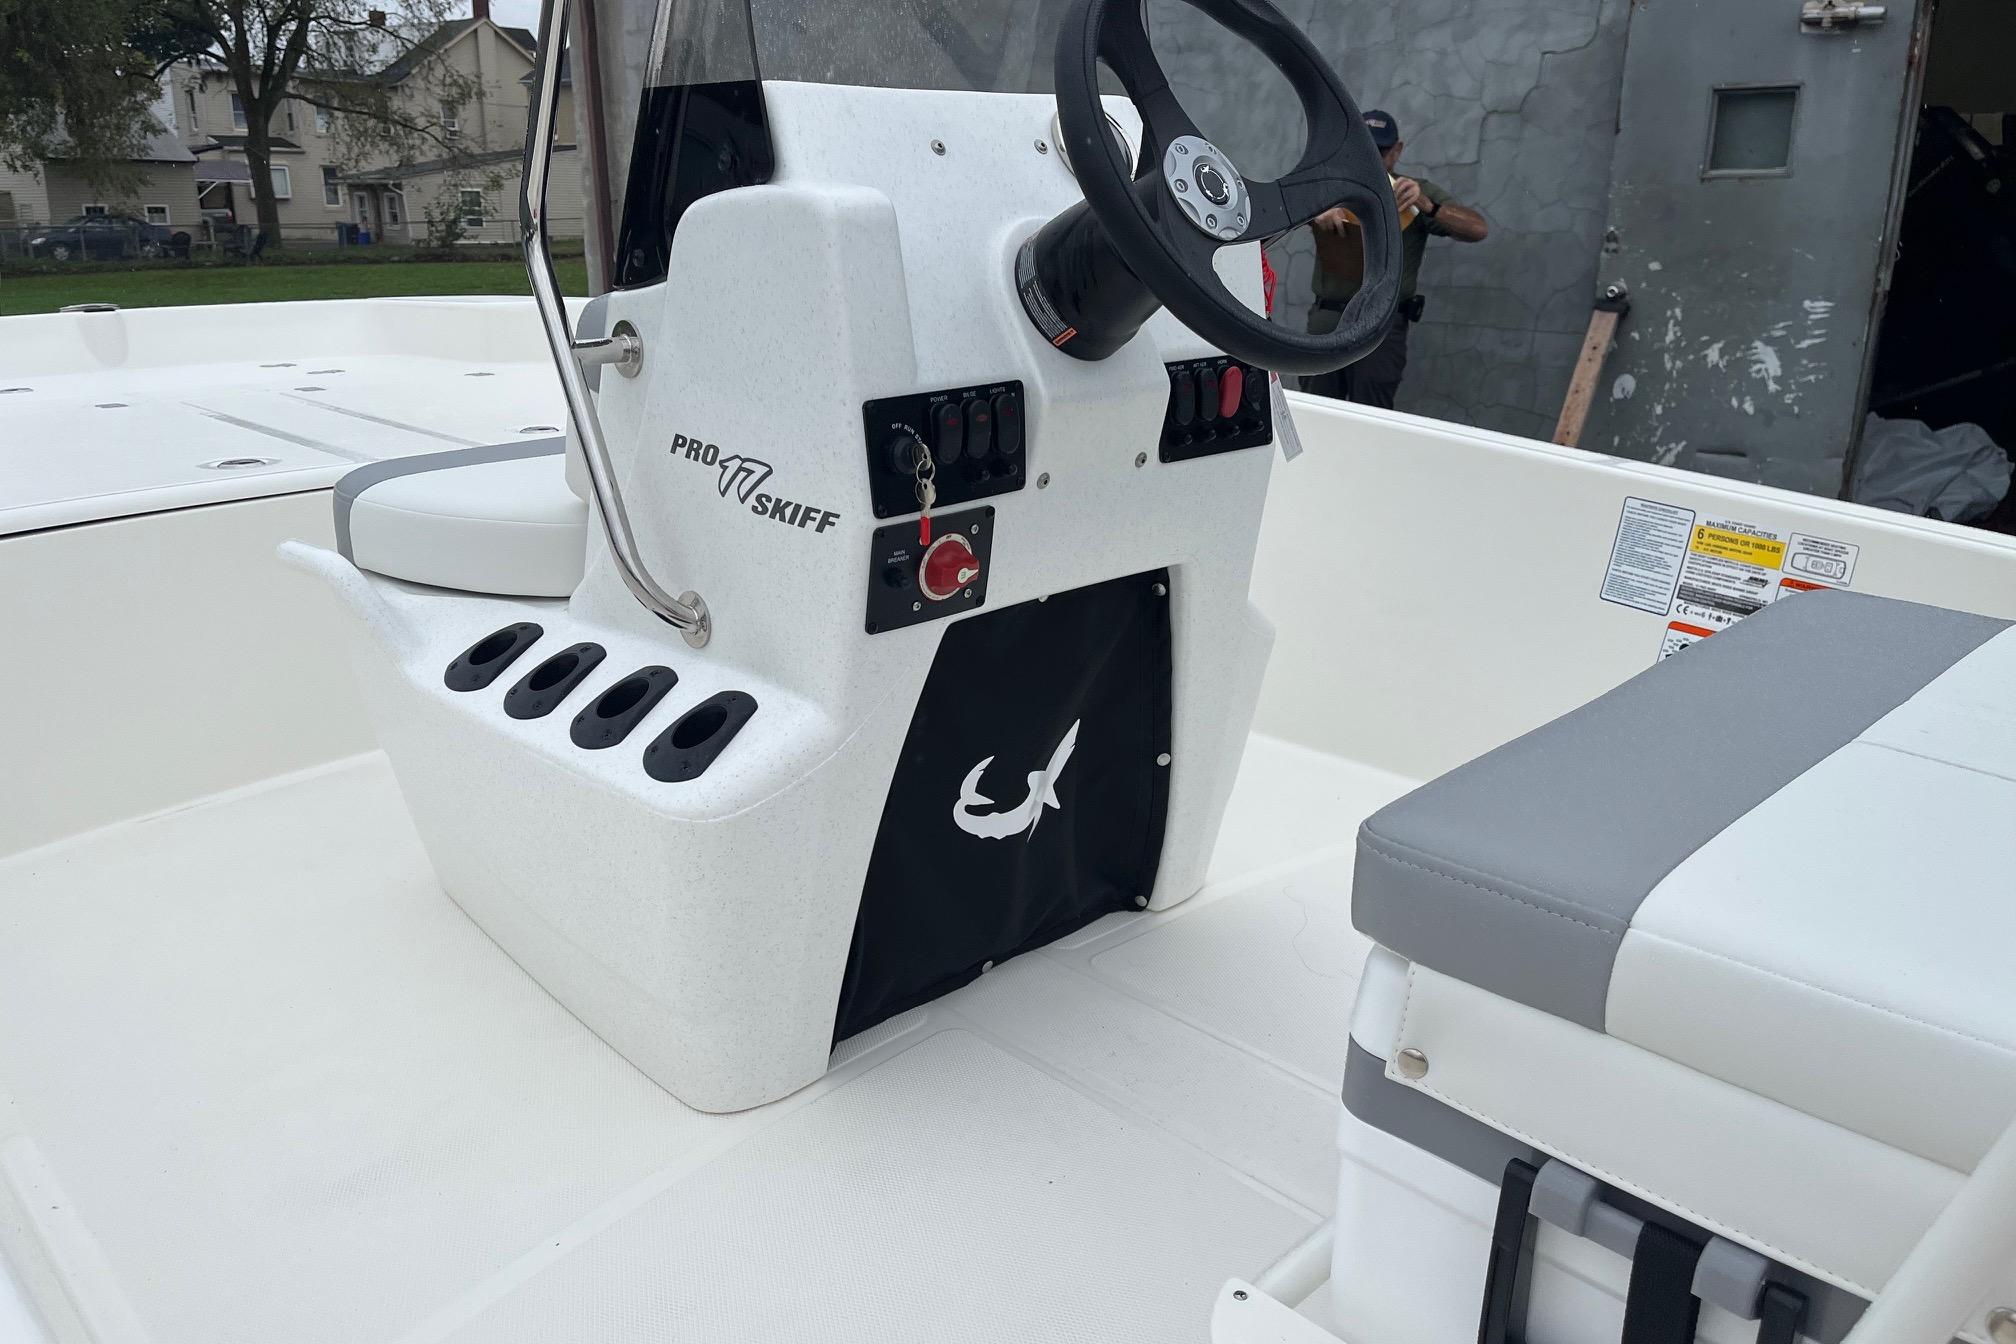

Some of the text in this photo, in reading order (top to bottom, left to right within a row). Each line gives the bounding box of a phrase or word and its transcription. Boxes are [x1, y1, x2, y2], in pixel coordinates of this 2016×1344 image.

[930, 394, 948, 403] POWER
[989, 386, 1006, 394] LIGHTS
[891, 422, 902, 430] OFF
[903, 424, 915, 435] RUN
[670, 433, 720, 467] PRO
[718, 454, 774, 505] 17
[751, 493, 841, 534] SKIFF
[1697, 528, 1705, 540] 6
[1708, 533, 1739, 545] PERSONS
[1740, 539, 1751, 548] OR
[1767, 545, 1781, 554] LBS
[1706, 520, 1737, 532] MAXIMUM
[1738, 527, 1778, 540] CAPACITIES
